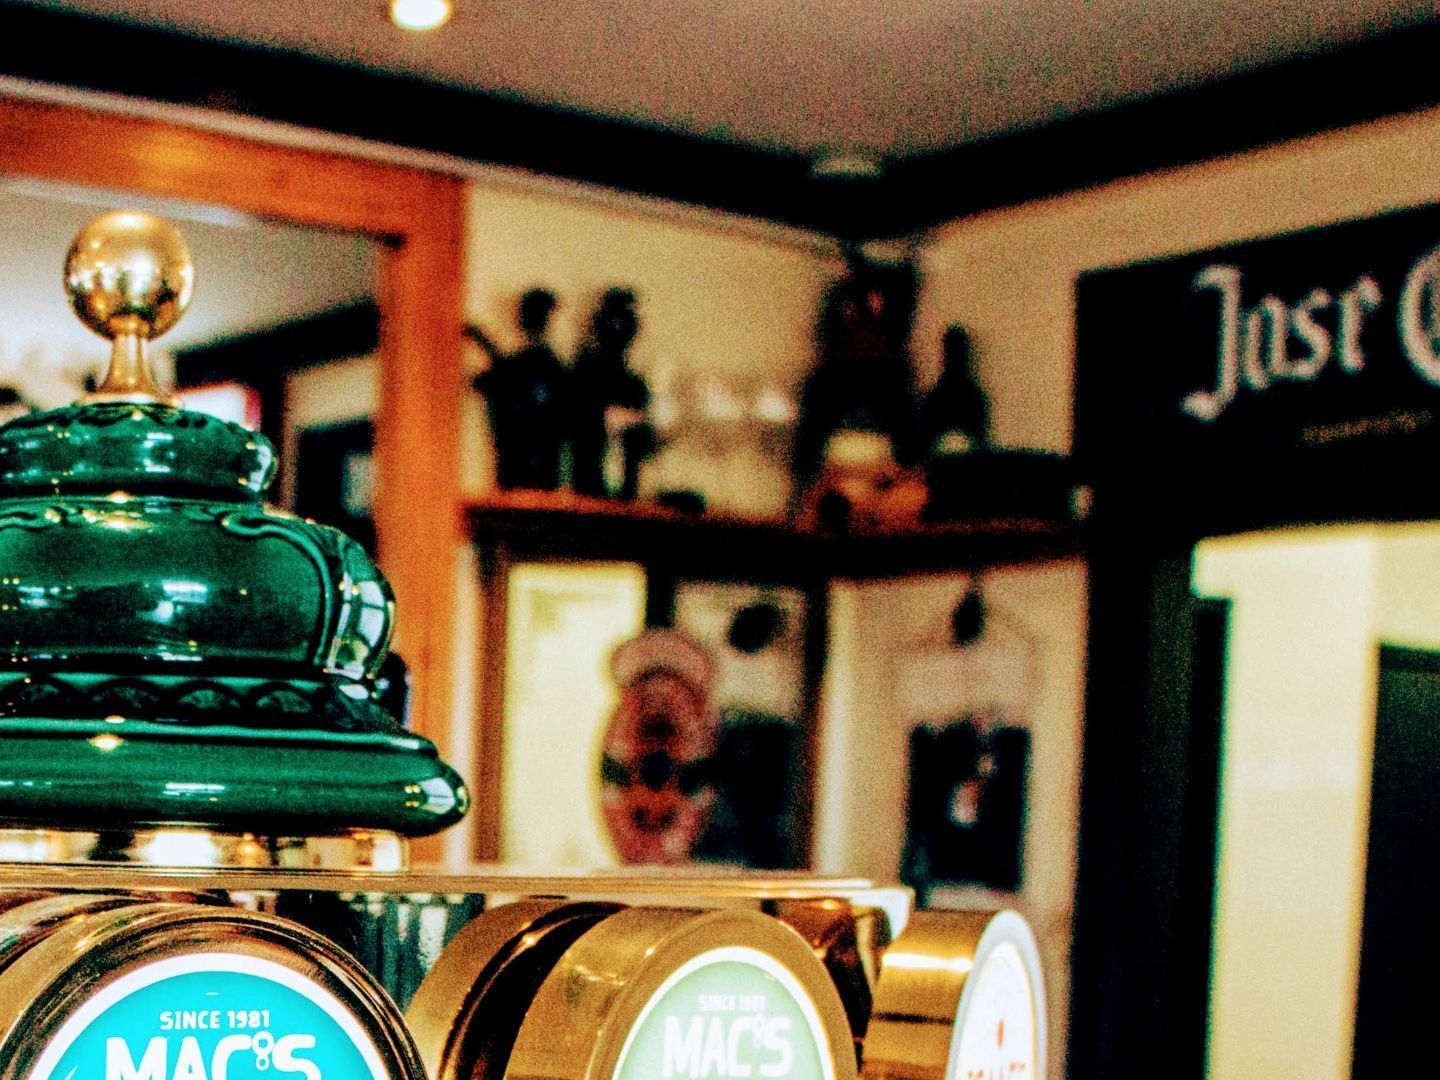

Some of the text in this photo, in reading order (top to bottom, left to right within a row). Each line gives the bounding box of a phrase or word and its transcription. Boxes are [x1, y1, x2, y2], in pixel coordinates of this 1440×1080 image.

[159, 1009, 271, 1030] SINCE 1981
[661, 1014, 795, 1079] MAC'S
